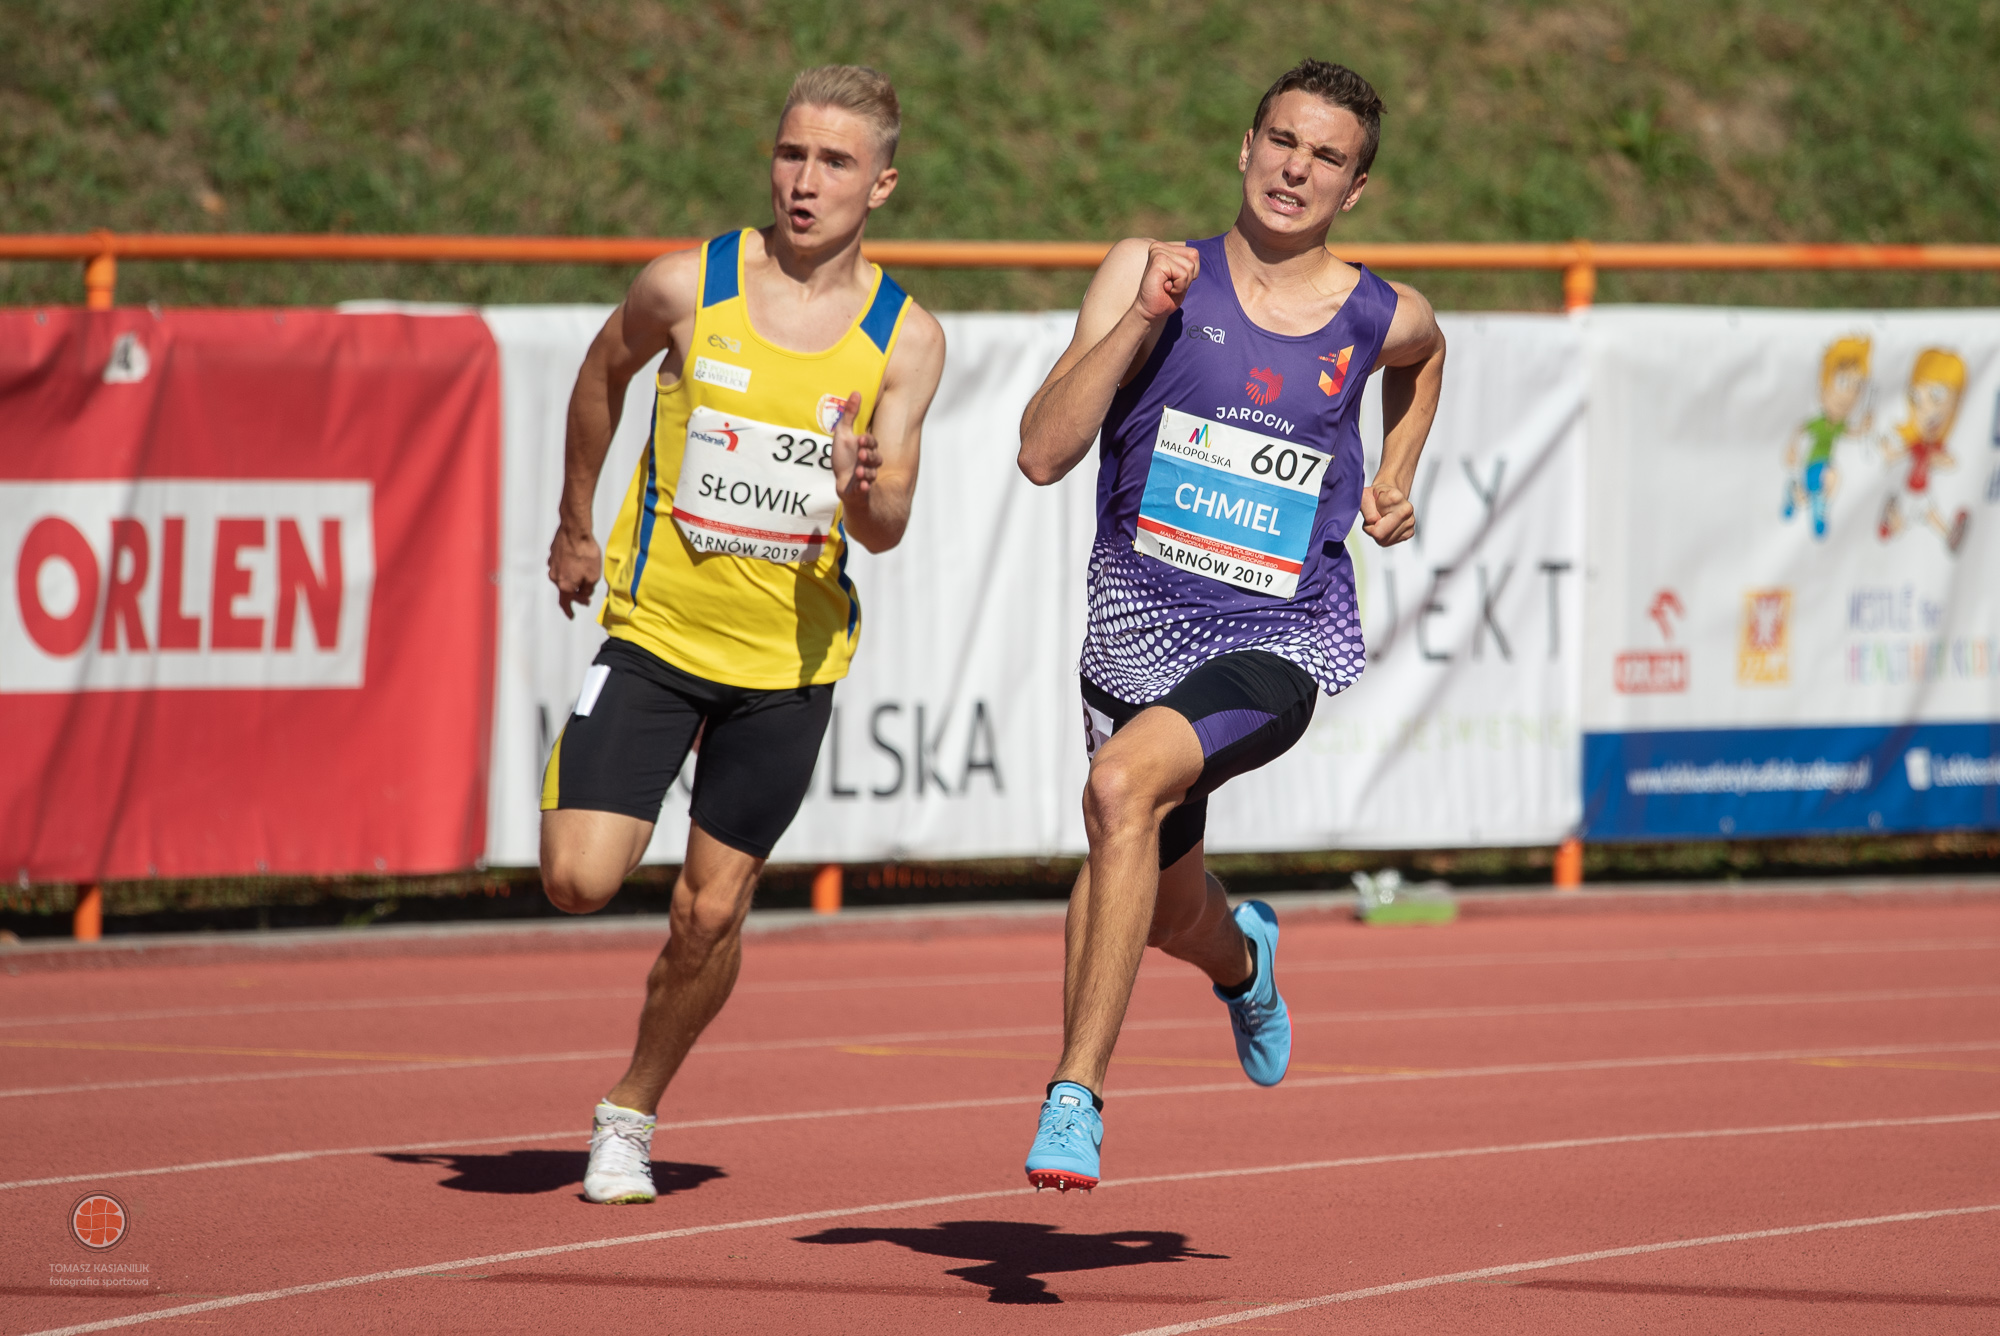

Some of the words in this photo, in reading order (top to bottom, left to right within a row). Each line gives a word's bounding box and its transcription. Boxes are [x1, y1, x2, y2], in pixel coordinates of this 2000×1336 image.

[690, 430, 726, 447] polanik
[1215, 406, 1295, 436] JAROCIN
[772, 433, 834, 471] 328
[1160, 439, 1231, 468] MAŁOPOLSKA
[1250, 443, 1322, 486] 607
[698, 473, 811, 517] SŁOWIK
[1174, 482, 1281, 537] CHMIEL
[689, 530, 758, 556] TARNÓW
[760, 545, 799, 561] 2019
[1158, 542, 1230, 576] TARNÓW
[1232, 566, 1274, 588] 2019
[16, 514, 345, 660] ORLEN
